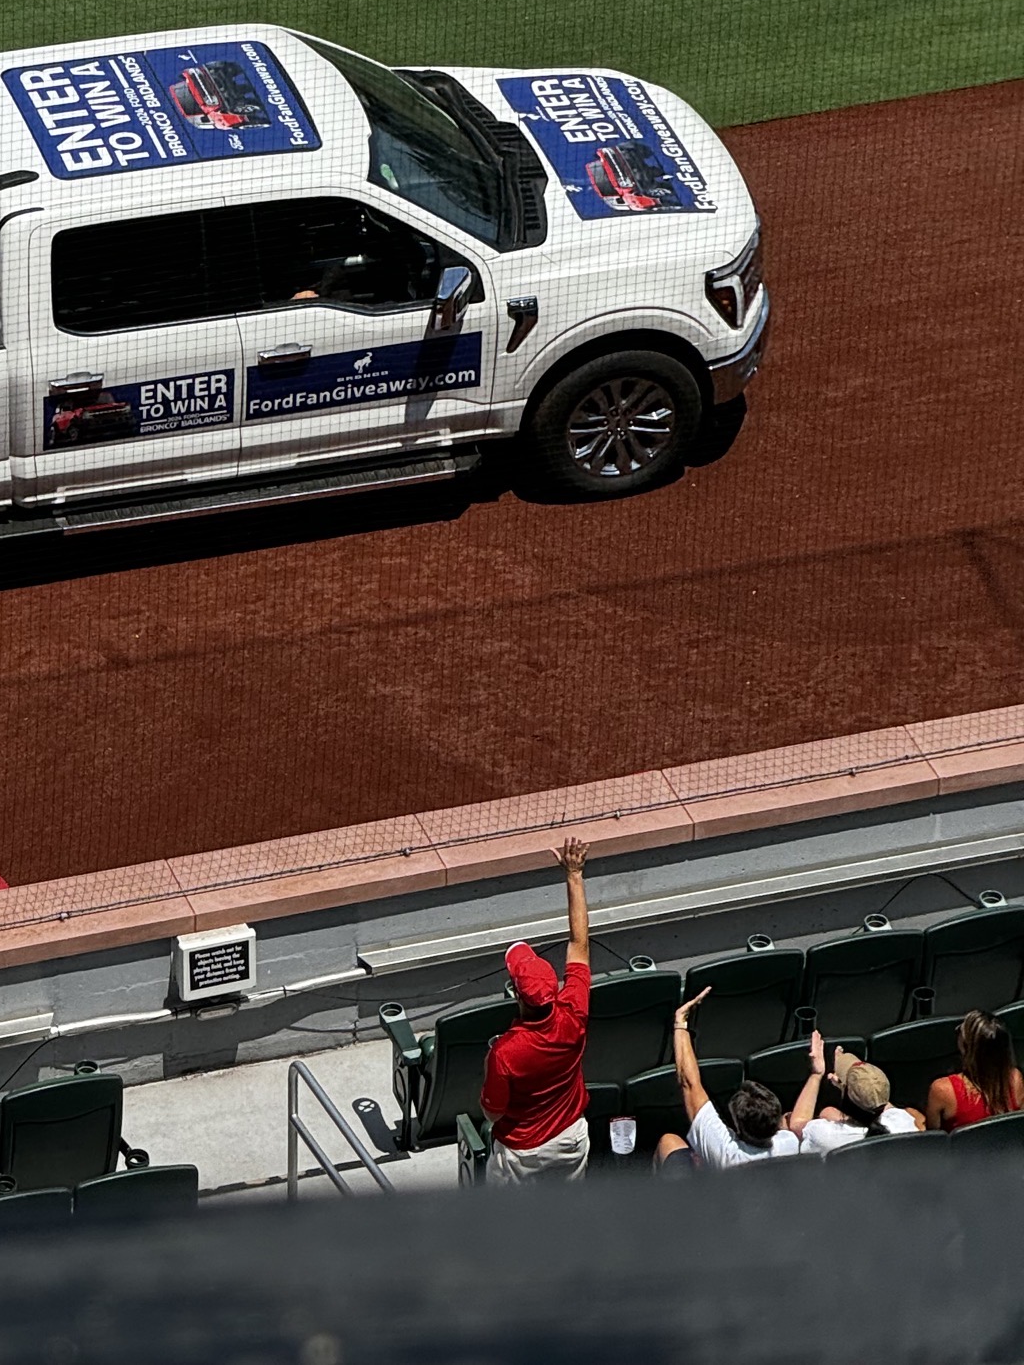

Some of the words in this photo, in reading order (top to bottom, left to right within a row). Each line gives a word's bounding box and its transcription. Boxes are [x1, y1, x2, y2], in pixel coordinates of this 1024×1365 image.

[70, 61, 105, 76] A
[241, 43, 308, 145] FordFanGiveaway.com
[562, 78, 585, 89] A
[79, 81, 131, 128] WIN
[124, 88, 143, 108] FORD
[569, 93, 605, 119] WIN
[20, 67, 113, 171] ENTER
[531, 79, 597, 143] ENTER
[592, 122, 620, 142] TO
[109, 132, 150, 166] TO
[140, 374, 227, 404] ENTER
[249, 369, 476, 414] FordFanGiveaway.com
[139, 403, 164, 419] TO
[171, 396, 209, 414] WIN
[214, 394, 227, 409] A
[193, 966, 211, 975] playing
[194, 974, 205, 982] your
[199, 977, 222, 986] protective
